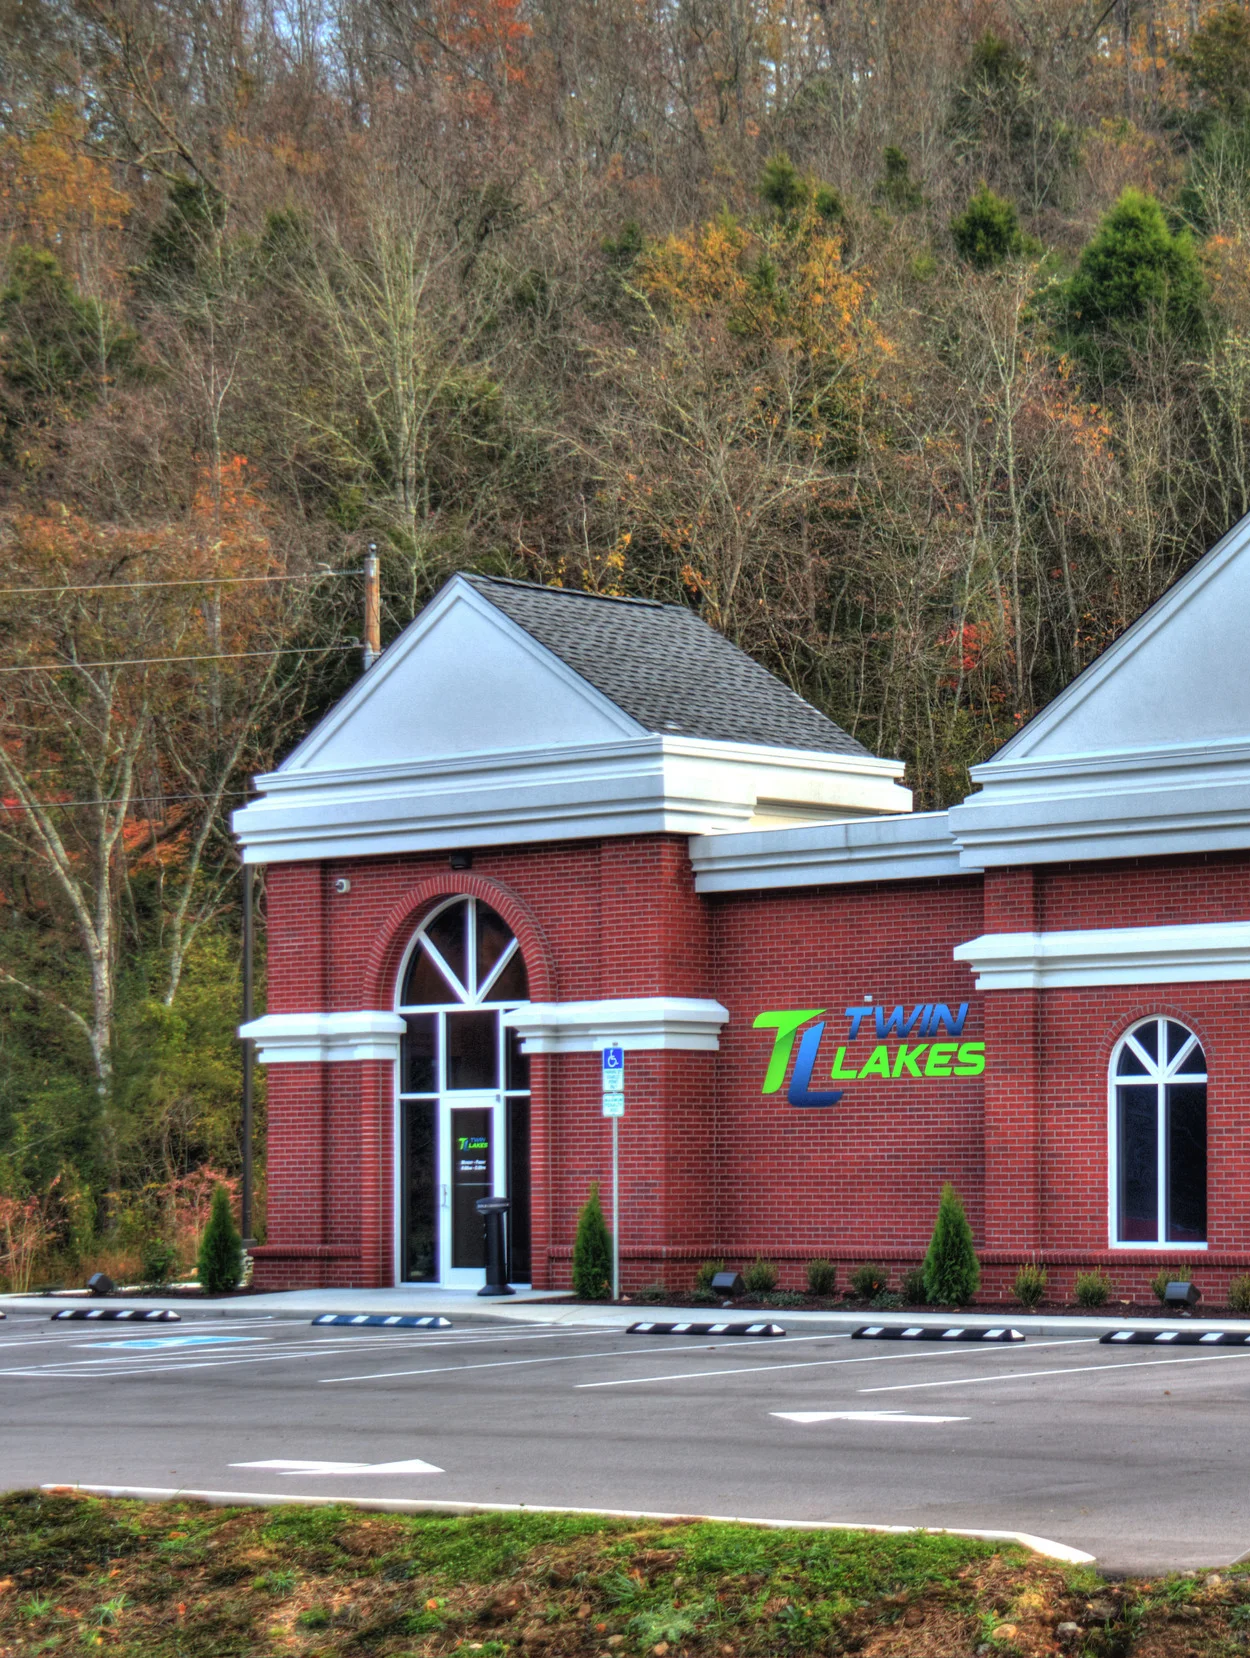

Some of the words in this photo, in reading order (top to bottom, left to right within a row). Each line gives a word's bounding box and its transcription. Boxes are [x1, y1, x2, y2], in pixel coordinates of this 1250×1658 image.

[844, 1002, 969, 1040] TWIN
[752, 1009, 844, 1108] TL
[831, 1042, 985, 1079] LAKES
